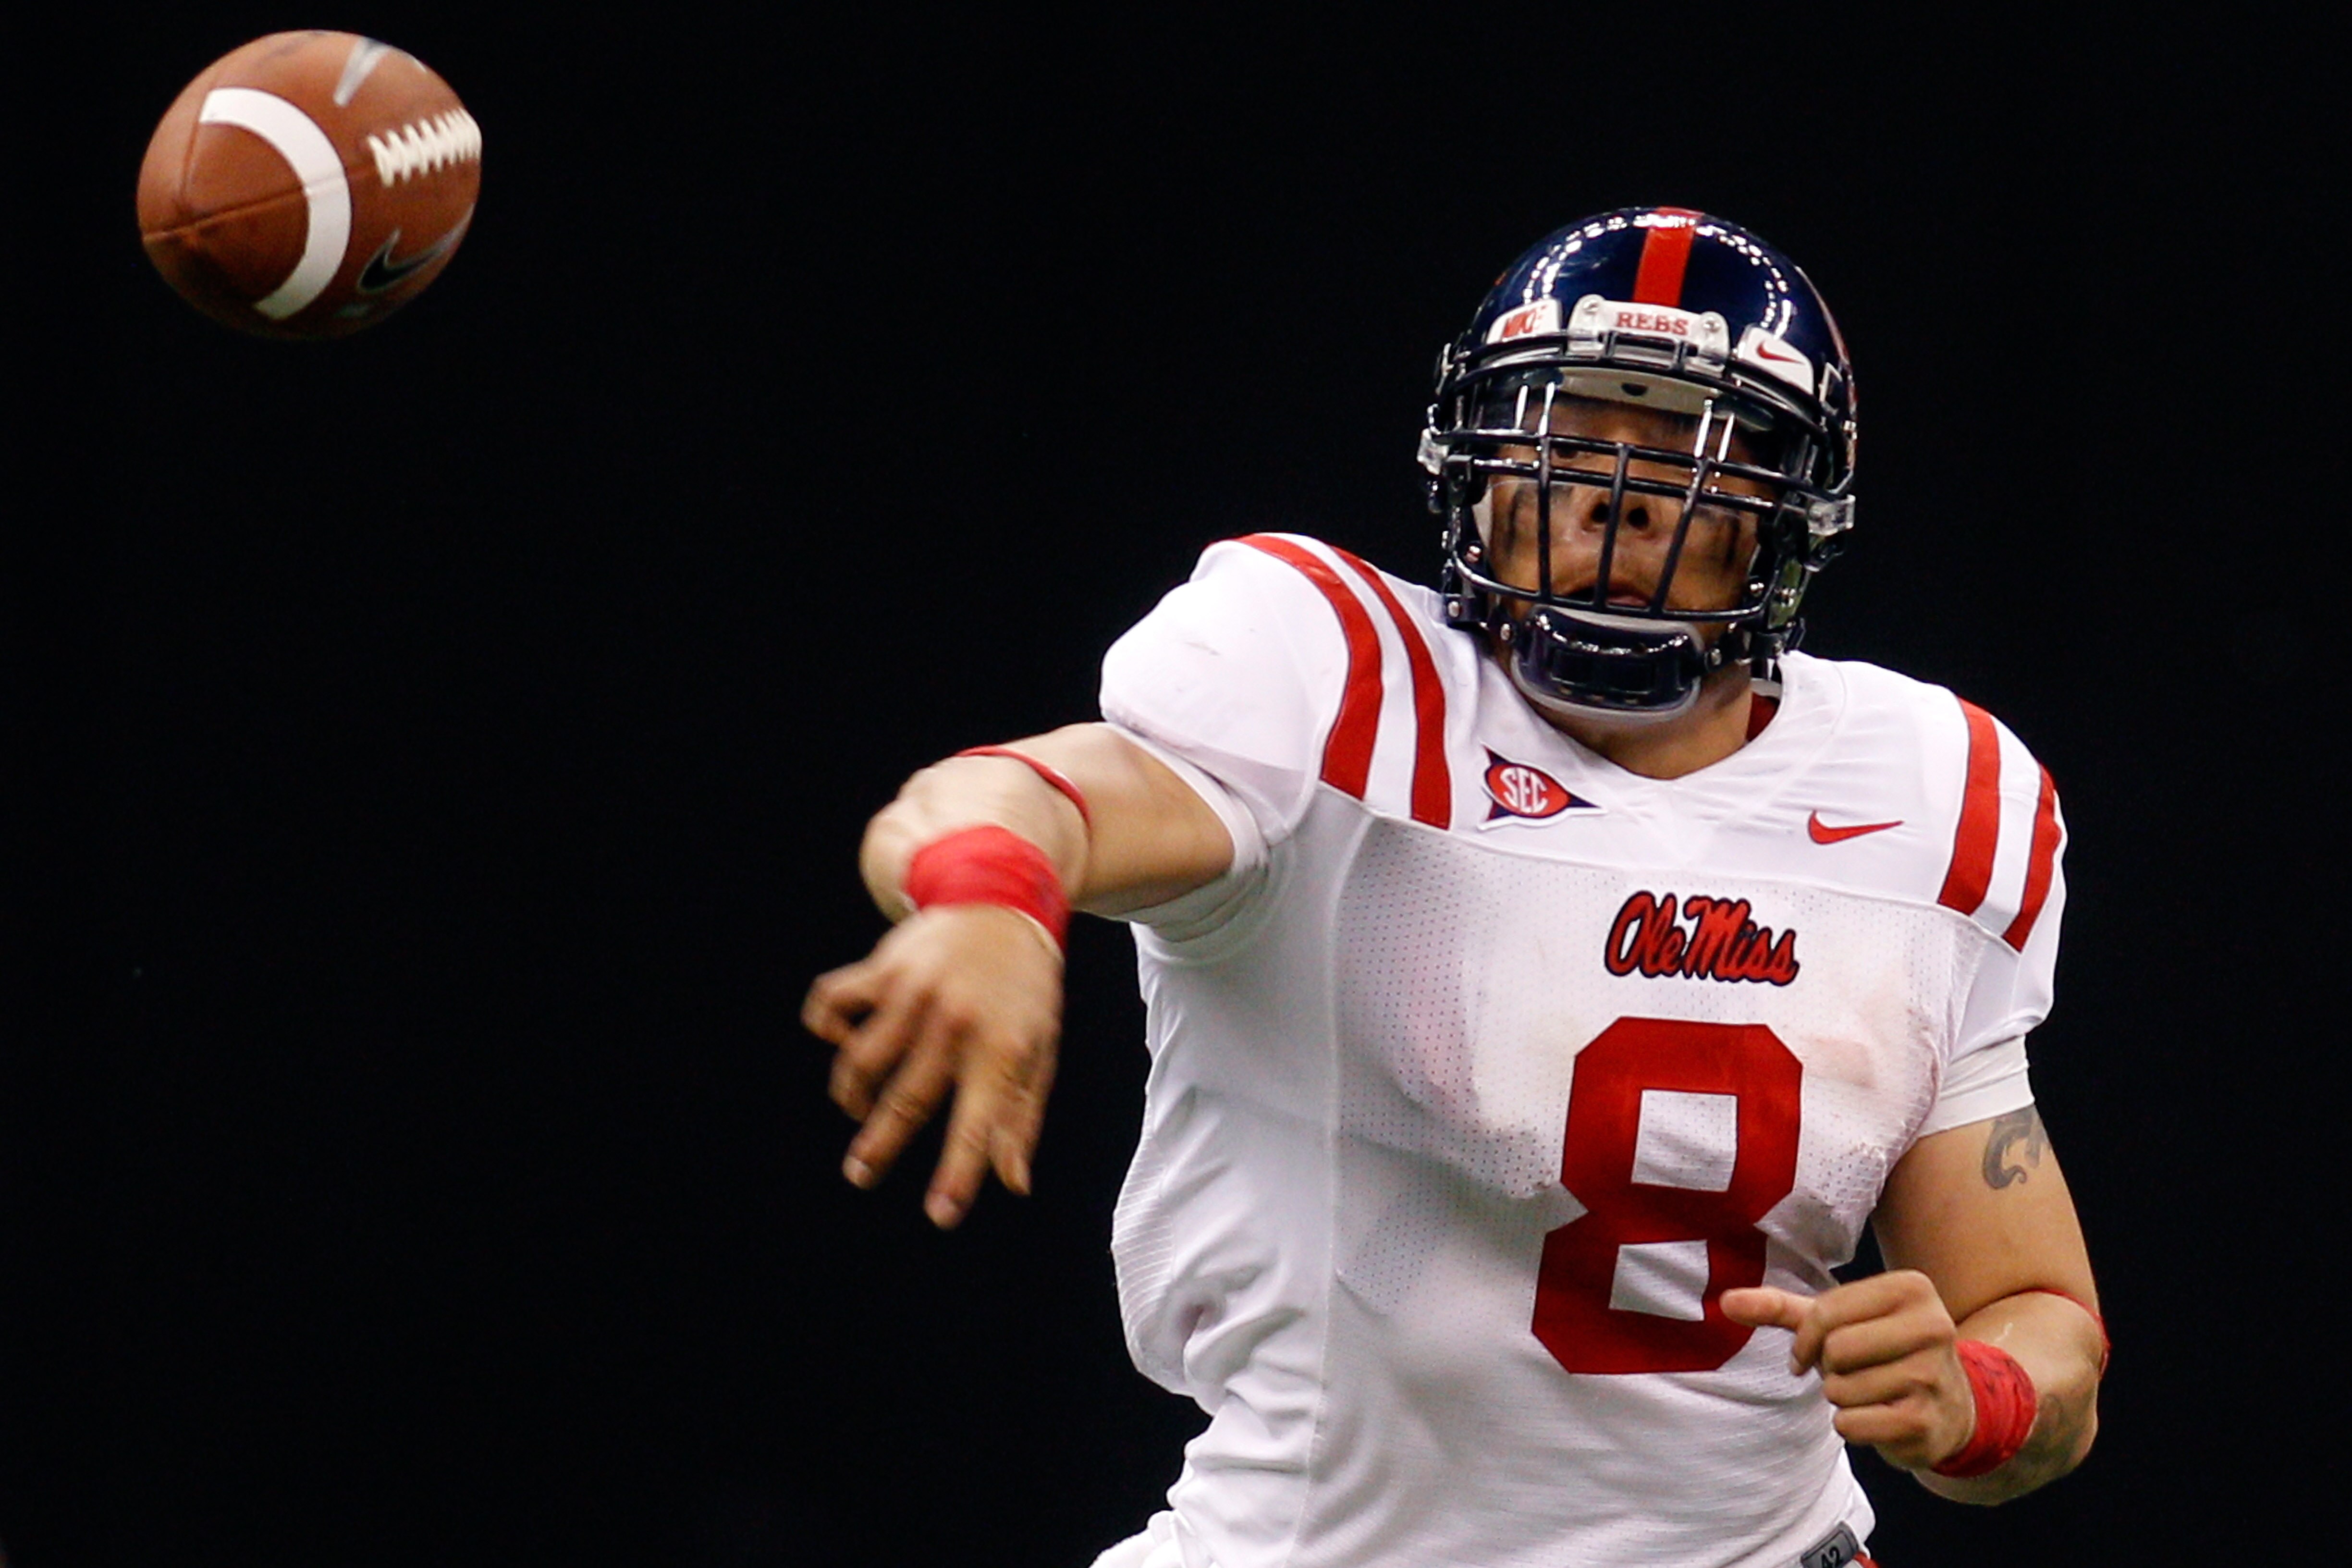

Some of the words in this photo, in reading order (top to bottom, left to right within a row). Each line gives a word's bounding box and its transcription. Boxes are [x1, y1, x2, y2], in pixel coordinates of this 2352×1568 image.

[1616, 312, 1689, 335] REBS
[1499, 767, 1548, 813] SEC
[1605, 890, 1686, 978] Ole
[1683, 895, 1800, 986] Miss
[1531, 1016, 1803, 1374] 8
